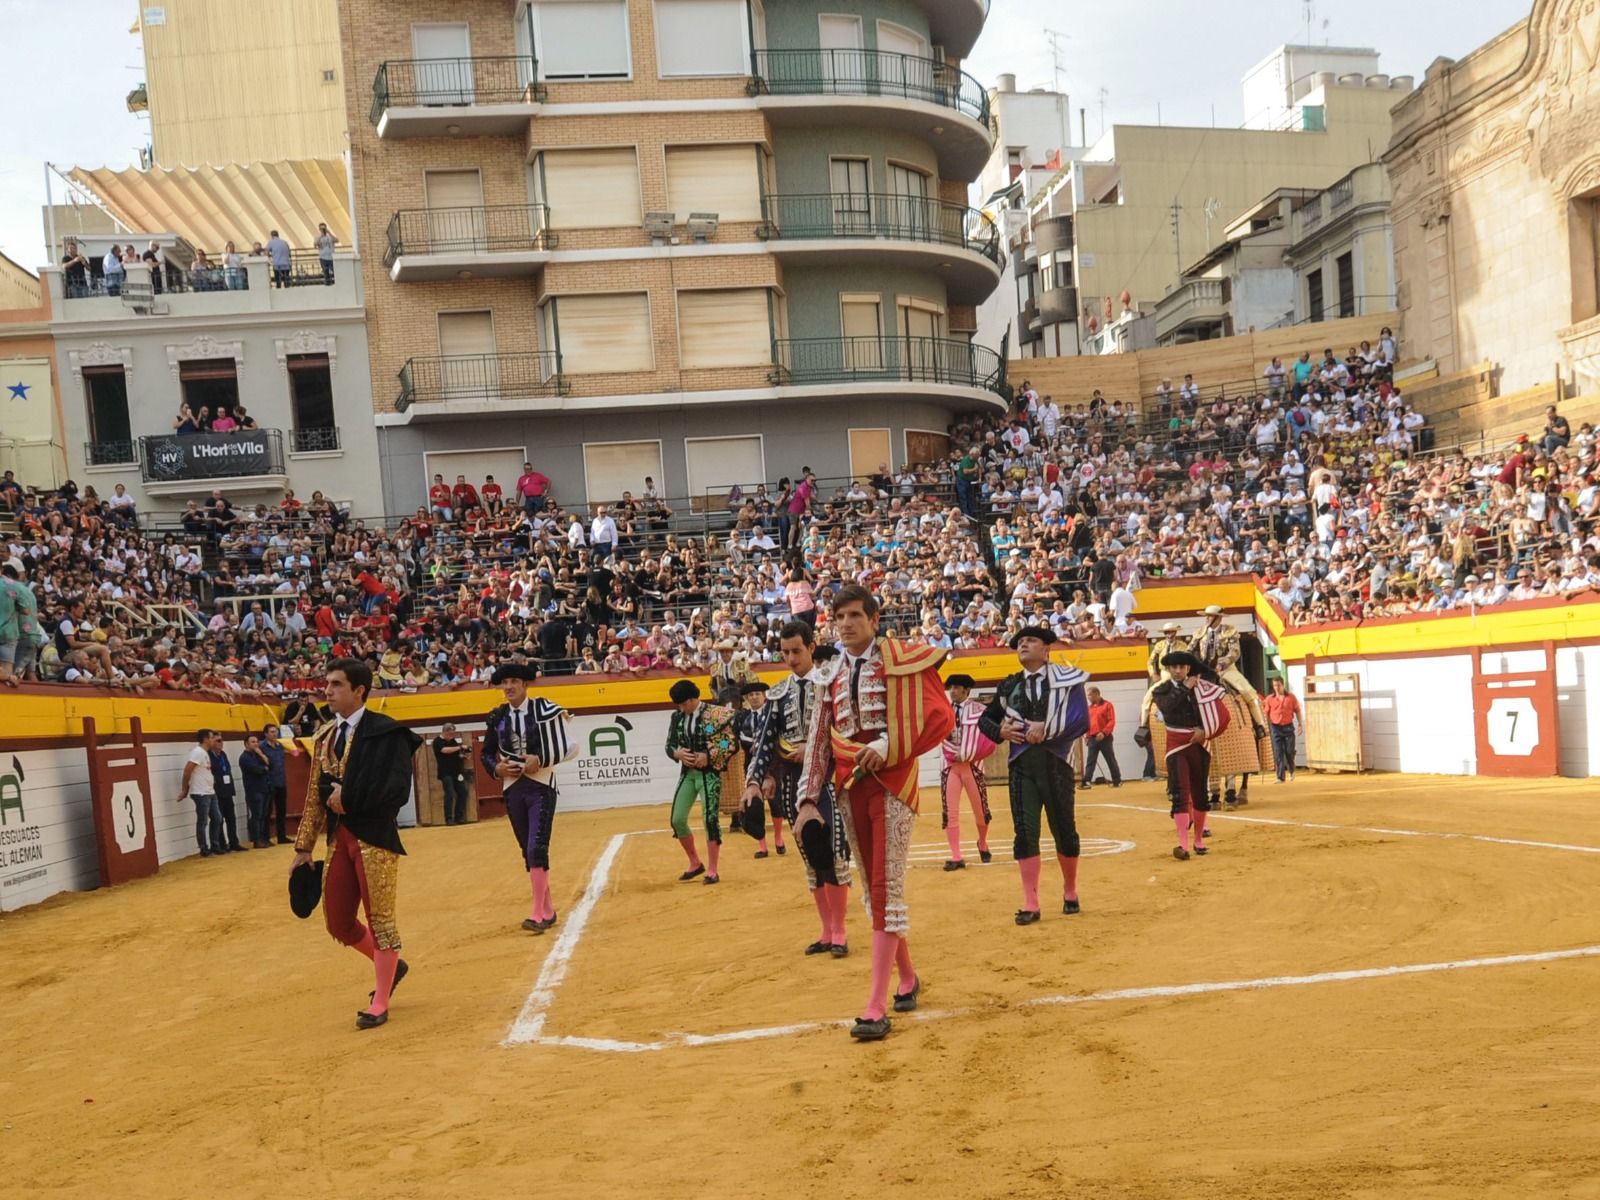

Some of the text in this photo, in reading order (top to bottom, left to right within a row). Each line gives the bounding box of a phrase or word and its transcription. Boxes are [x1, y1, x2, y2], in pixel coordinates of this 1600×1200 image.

[192, 444, 228, 458] L'Hort
[237, 442, 264, 455] Vila
[162, 453, 178, 463] HV
[1506, 711, 1518, 742] 7
[578, 756, 649, 768] DESGUACES
[579, 770, 593, 780] EL
[125, 795, 135, 838] 3
